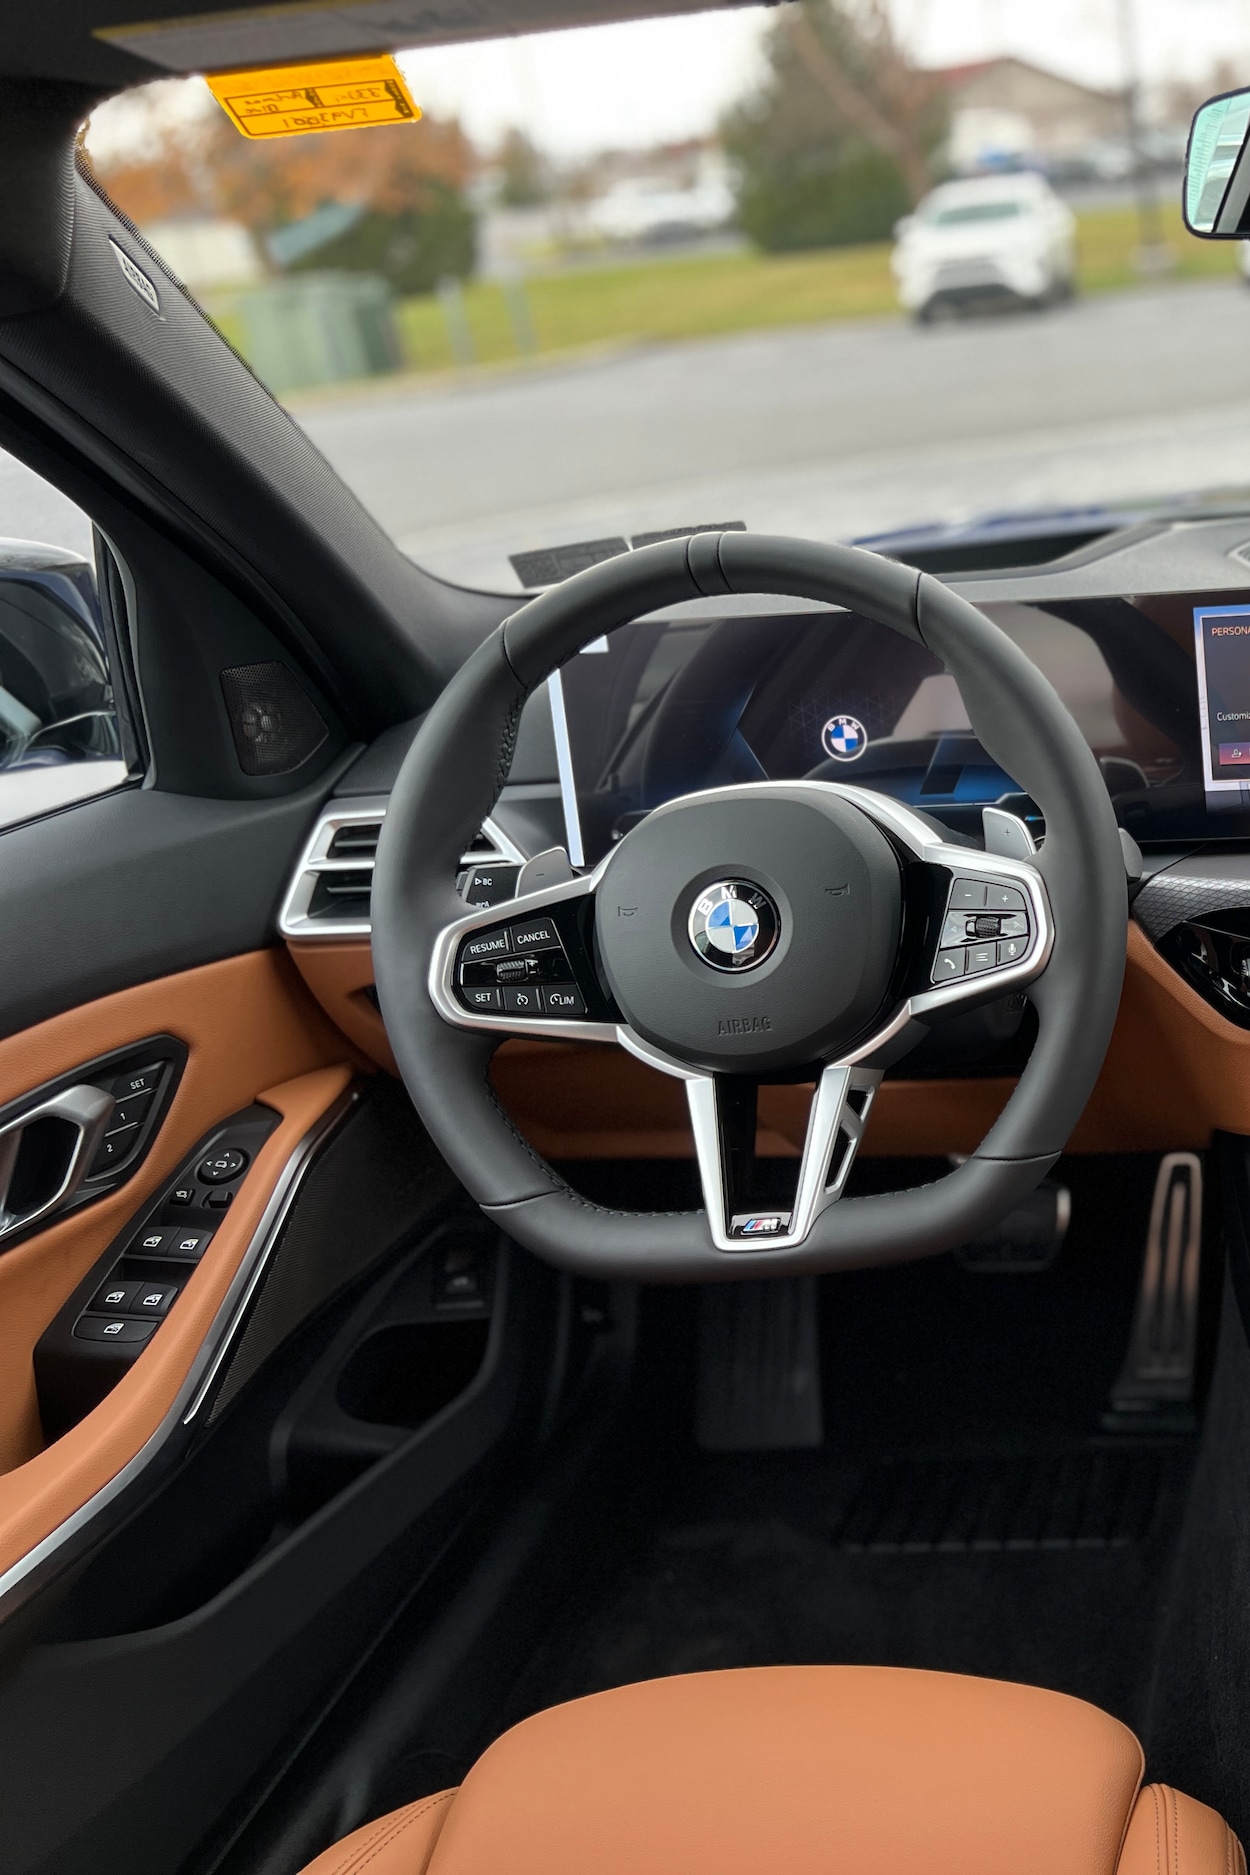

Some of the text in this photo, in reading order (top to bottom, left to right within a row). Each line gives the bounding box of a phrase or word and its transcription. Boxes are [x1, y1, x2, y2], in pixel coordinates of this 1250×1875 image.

[517, 930, 550, 945] CANCEL
[470, 938, 505, 955] RESUME
[475, 992, 491, 1002] SET
[559, 995, 574, 1005] LIM
[717, 1016, 773, 1036] AIRBAG
[129, 1078, 145, 1090] SET
[120, 1112, 126, 1120] 1
[106, 1144, 114, 1152] 2
